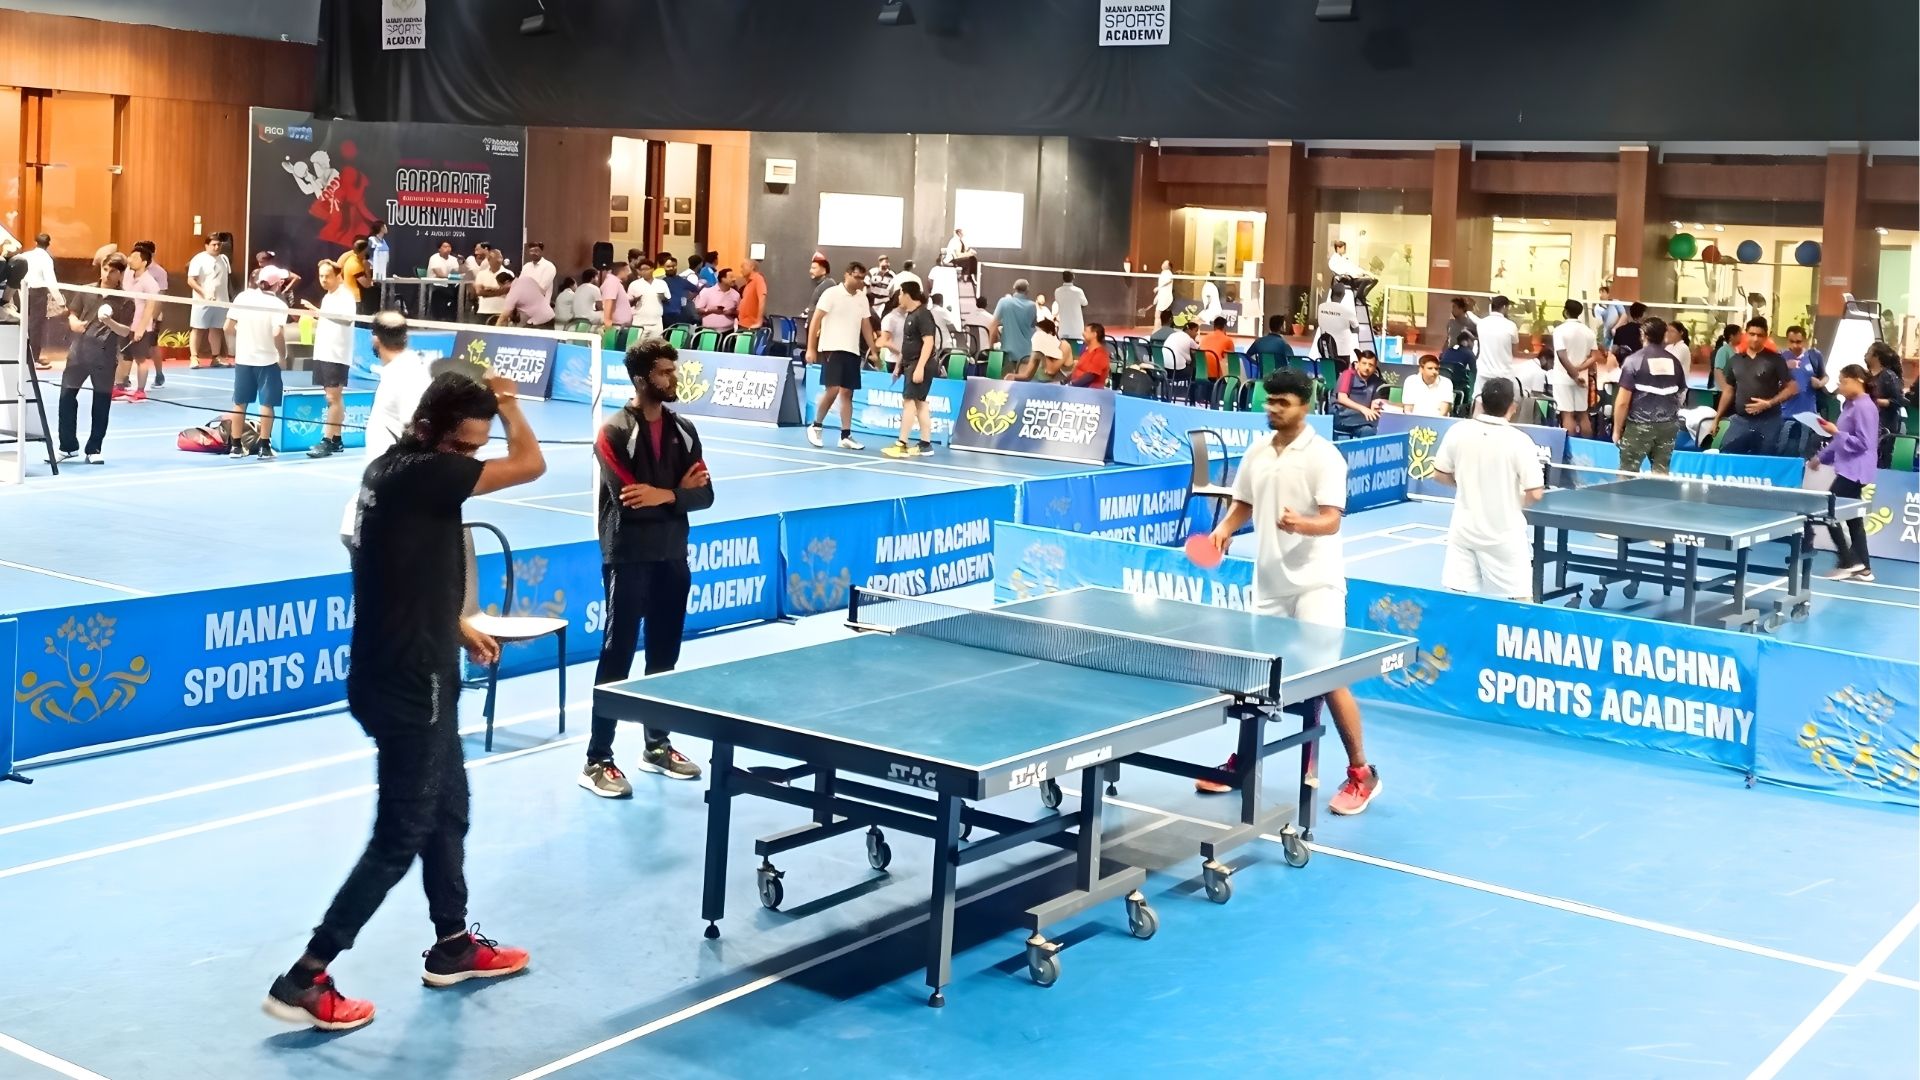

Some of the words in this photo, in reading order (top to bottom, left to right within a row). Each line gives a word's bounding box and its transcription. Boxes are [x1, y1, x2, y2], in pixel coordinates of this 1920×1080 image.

[1105, 13, 1165, 28] SPORTS
[1105, 29, 1163, 41] ACADEMY
[396, 168, 491, 198] CORPORATE
[386, 199, 497, 229] TOURNAMENT
[494, 354, 546, 373] SPORTS
[498, 369, 543, 384] CADEMY
[1022, 407, 1100, 432] SPORTS
[1025, 399, 1060, 410] MANAV
[1018, 424, 1097, 444] ACADEMY
[1099, 494, 1141, 521] MANAV
[687, 536, 761, 573] RACHNA
[875, 530, 933, 564] MANAV
[933, 517, 991, 555] RACHNA
[686, 575, 767, 615] CADEMY
[1123, 567, 1204, 607] MANAV
[205, 599, 318, 651] MANAV
[1496, 623, 1603, 672] MANAV
[1612, 640, 1742, 693] RACHNA
[183, 652, 305, 707] SPORTS
[1477, 668, 1593, 719] SPORTS
[1600, 688, 1755, 747] ACADEMY
